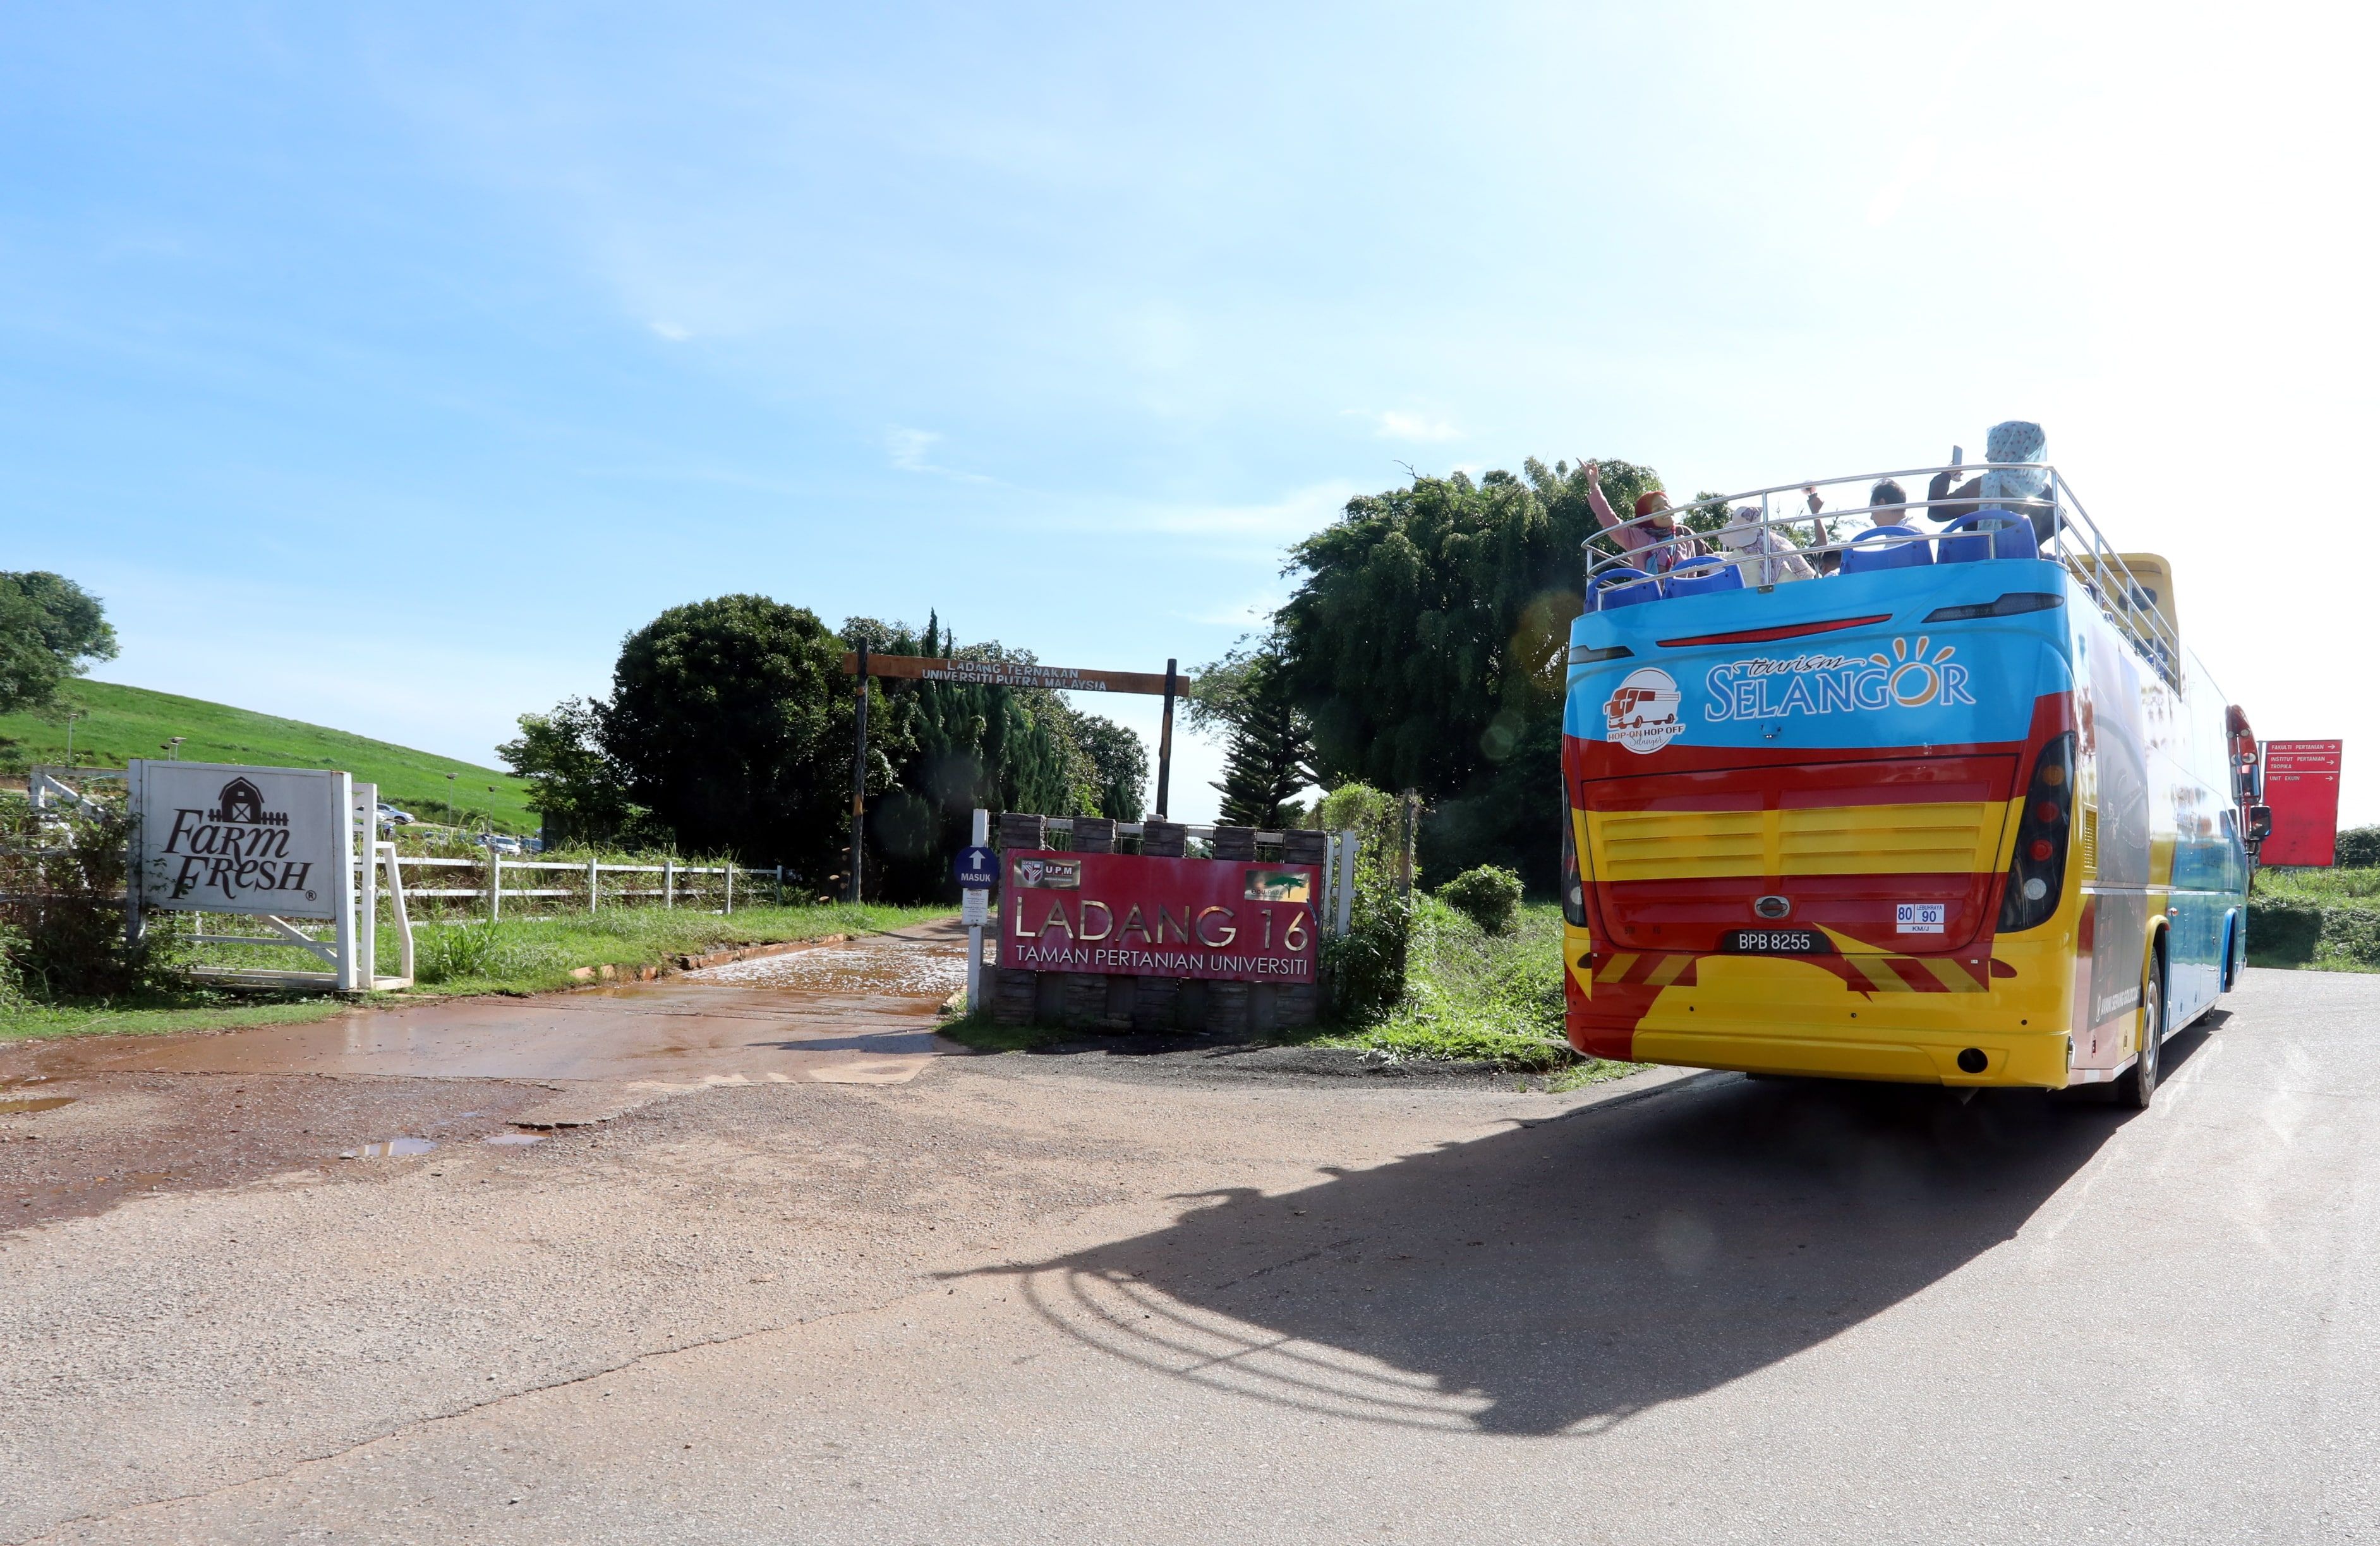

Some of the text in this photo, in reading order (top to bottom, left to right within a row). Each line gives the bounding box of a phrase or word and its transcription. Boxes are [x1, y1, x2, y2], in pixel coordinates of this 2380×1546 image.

[948, 660, 1079, 679] LADANG TERNAKAN
[1733, 655, 1865, 675] tourism
[922, 669, 1107, 691] UNIVERSITI PUTRA MALAYSIA
[1706, 663, 1976, 722] SELANGOR
[1609, 726, 1684, 740] HOP-ON HOP OFF
[961, 873, 991, 882] MASUK
[1898, 907, 1912, 920] 80
[1922, 911, 1936, 922] 90
[1016, 896, 1308, 951] LADANG 16
[1739, 934, 1810, 950] BPB 8255
[1016, 945, 1307, 975] TAMAN PERTANIAN UNIVERSITI
